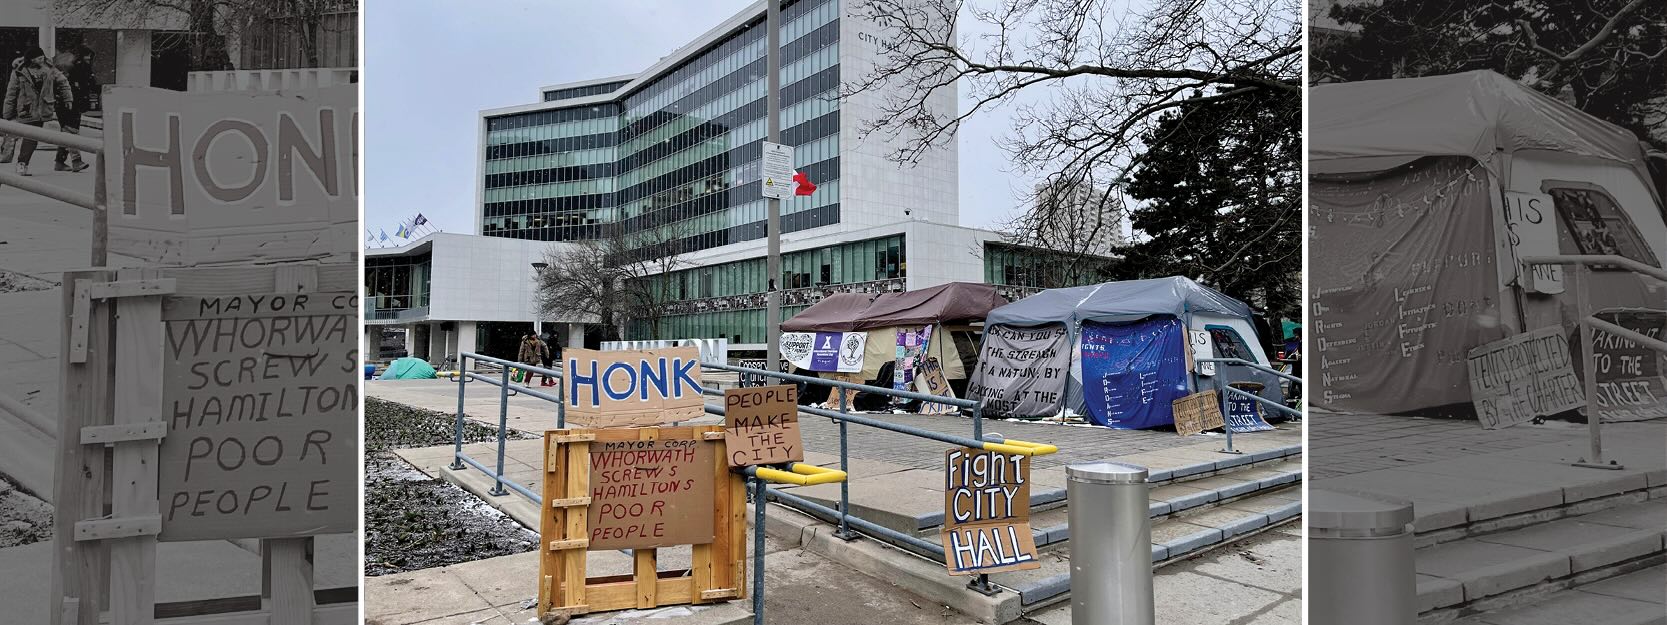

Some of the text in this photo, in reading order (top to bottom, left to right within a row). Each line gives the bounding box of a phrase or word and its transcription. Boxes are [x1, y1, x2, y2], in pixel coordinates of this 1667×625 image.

[858, 31, 878, 45] CITY
[121, 109, 358, 217] HON
[200, 294, 309, 317] MAYOR
[165, 315, 358, 360] WHORWA
[1029, 330, 1051, 340] YOU
[1044, 367, 1061, 379] BY
[1472, 333, 1570, 391] TENTS PROTECTED
[1592, 353, 1611, 374] TO
[1620, 355, 1643, 375] THE
[569, 357, 703, 408] HONK
[1596, 381, 1660, 407] STREET
[727, 387, 796, 412] PEOPLE
[986, 399, 1018, 411] MOST
[1035, 391, 1057, 404] THE
[1240, 402, 1252, 412] THE
[1482, 398, 1501, 427] BY
[1527, 373, 1587, 413] CHARTER
[734, 412, 791, 436] MAKE
[605, 440, 696, 450] MAYOR CORP
[747, 432, 785, 447] THE
[185, 430, 332, 482] POOR
[590, 448, 696, 471] WHORWATH
[733, 446, 794, 466] CITY
[948, 450, 1025, 490] Fight
[168, 480, 330, 521] PEOPLE
[599, 500, 665, 524] POOR
[953, 486, 1019, 522] CITY
[592, 522, 665, 542] PEOPLE
[950, 526, 1033, 570] HALL
